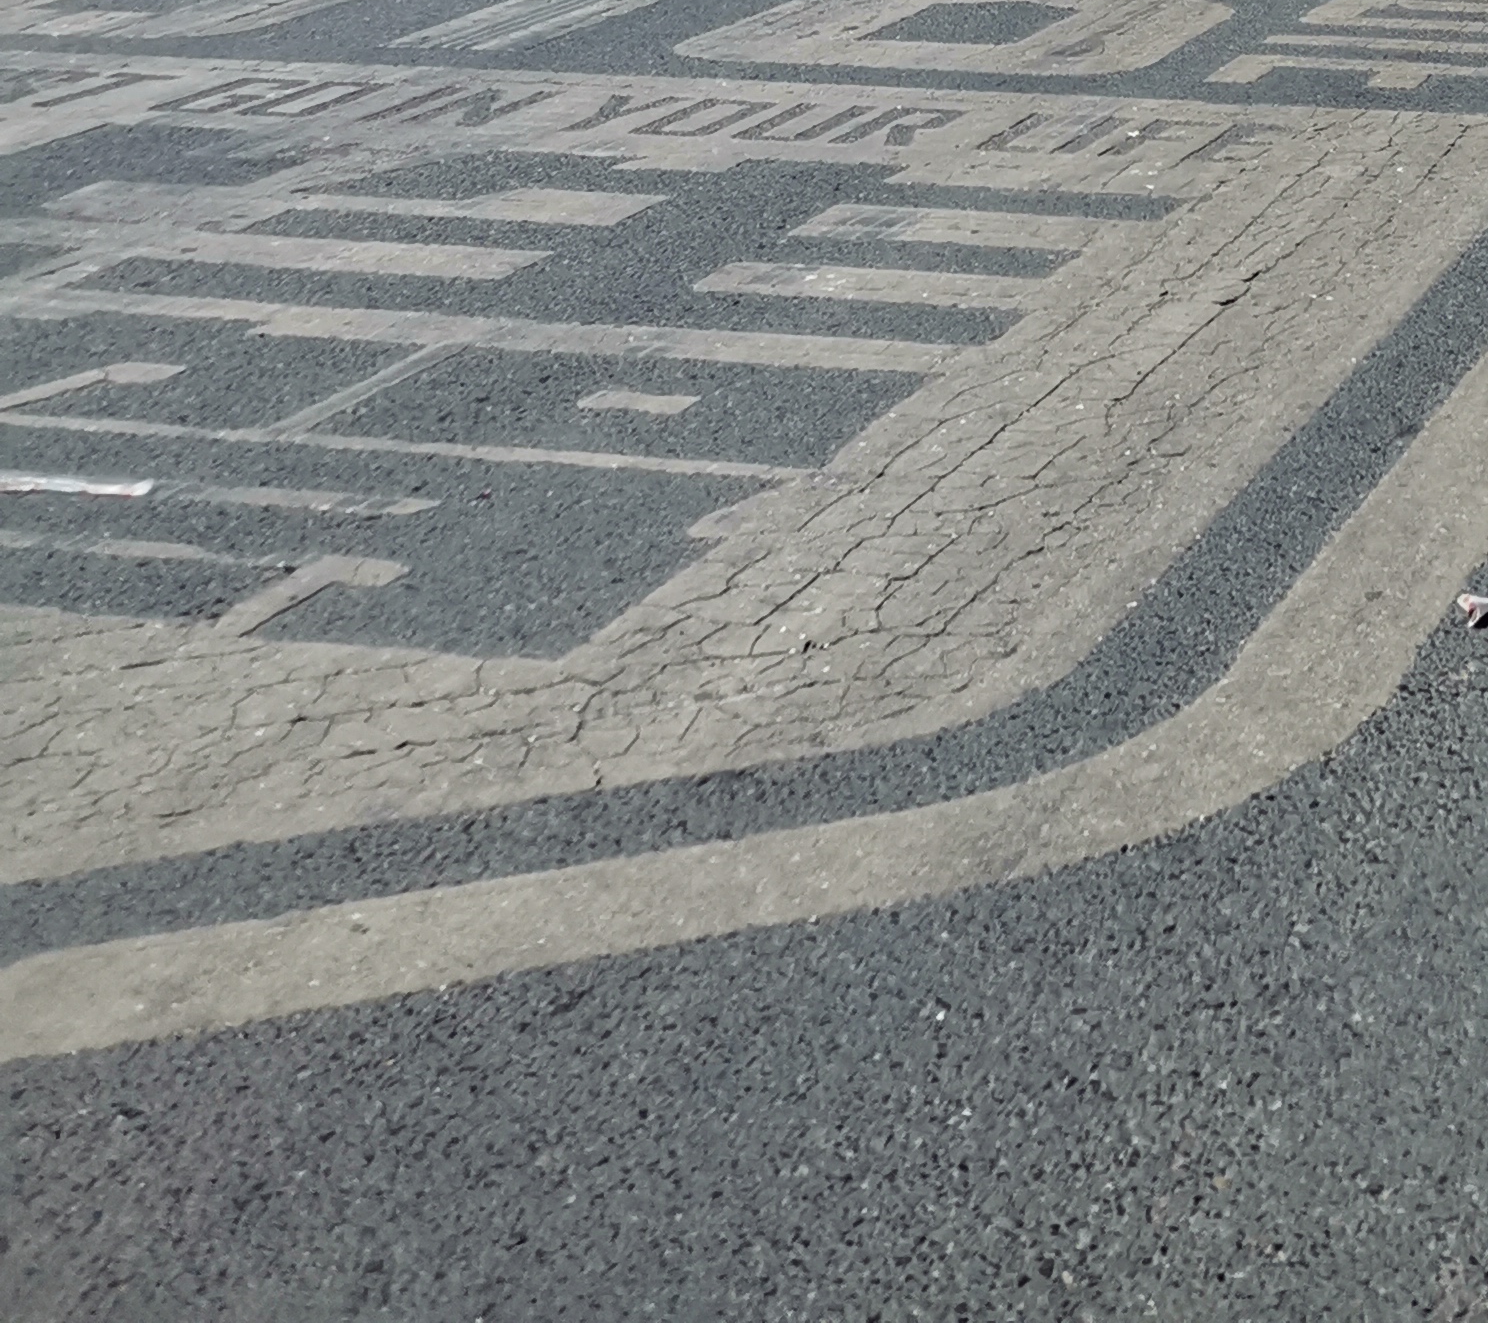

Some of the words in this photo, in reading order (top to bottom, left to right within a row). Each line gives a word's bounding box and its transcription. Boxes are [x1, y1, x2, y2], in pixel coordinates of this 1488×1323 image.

[147, 77, 394, 117] GO
[557, 94, 970, 146] YOUR
[975, 112, 1295, 163] LIFE
